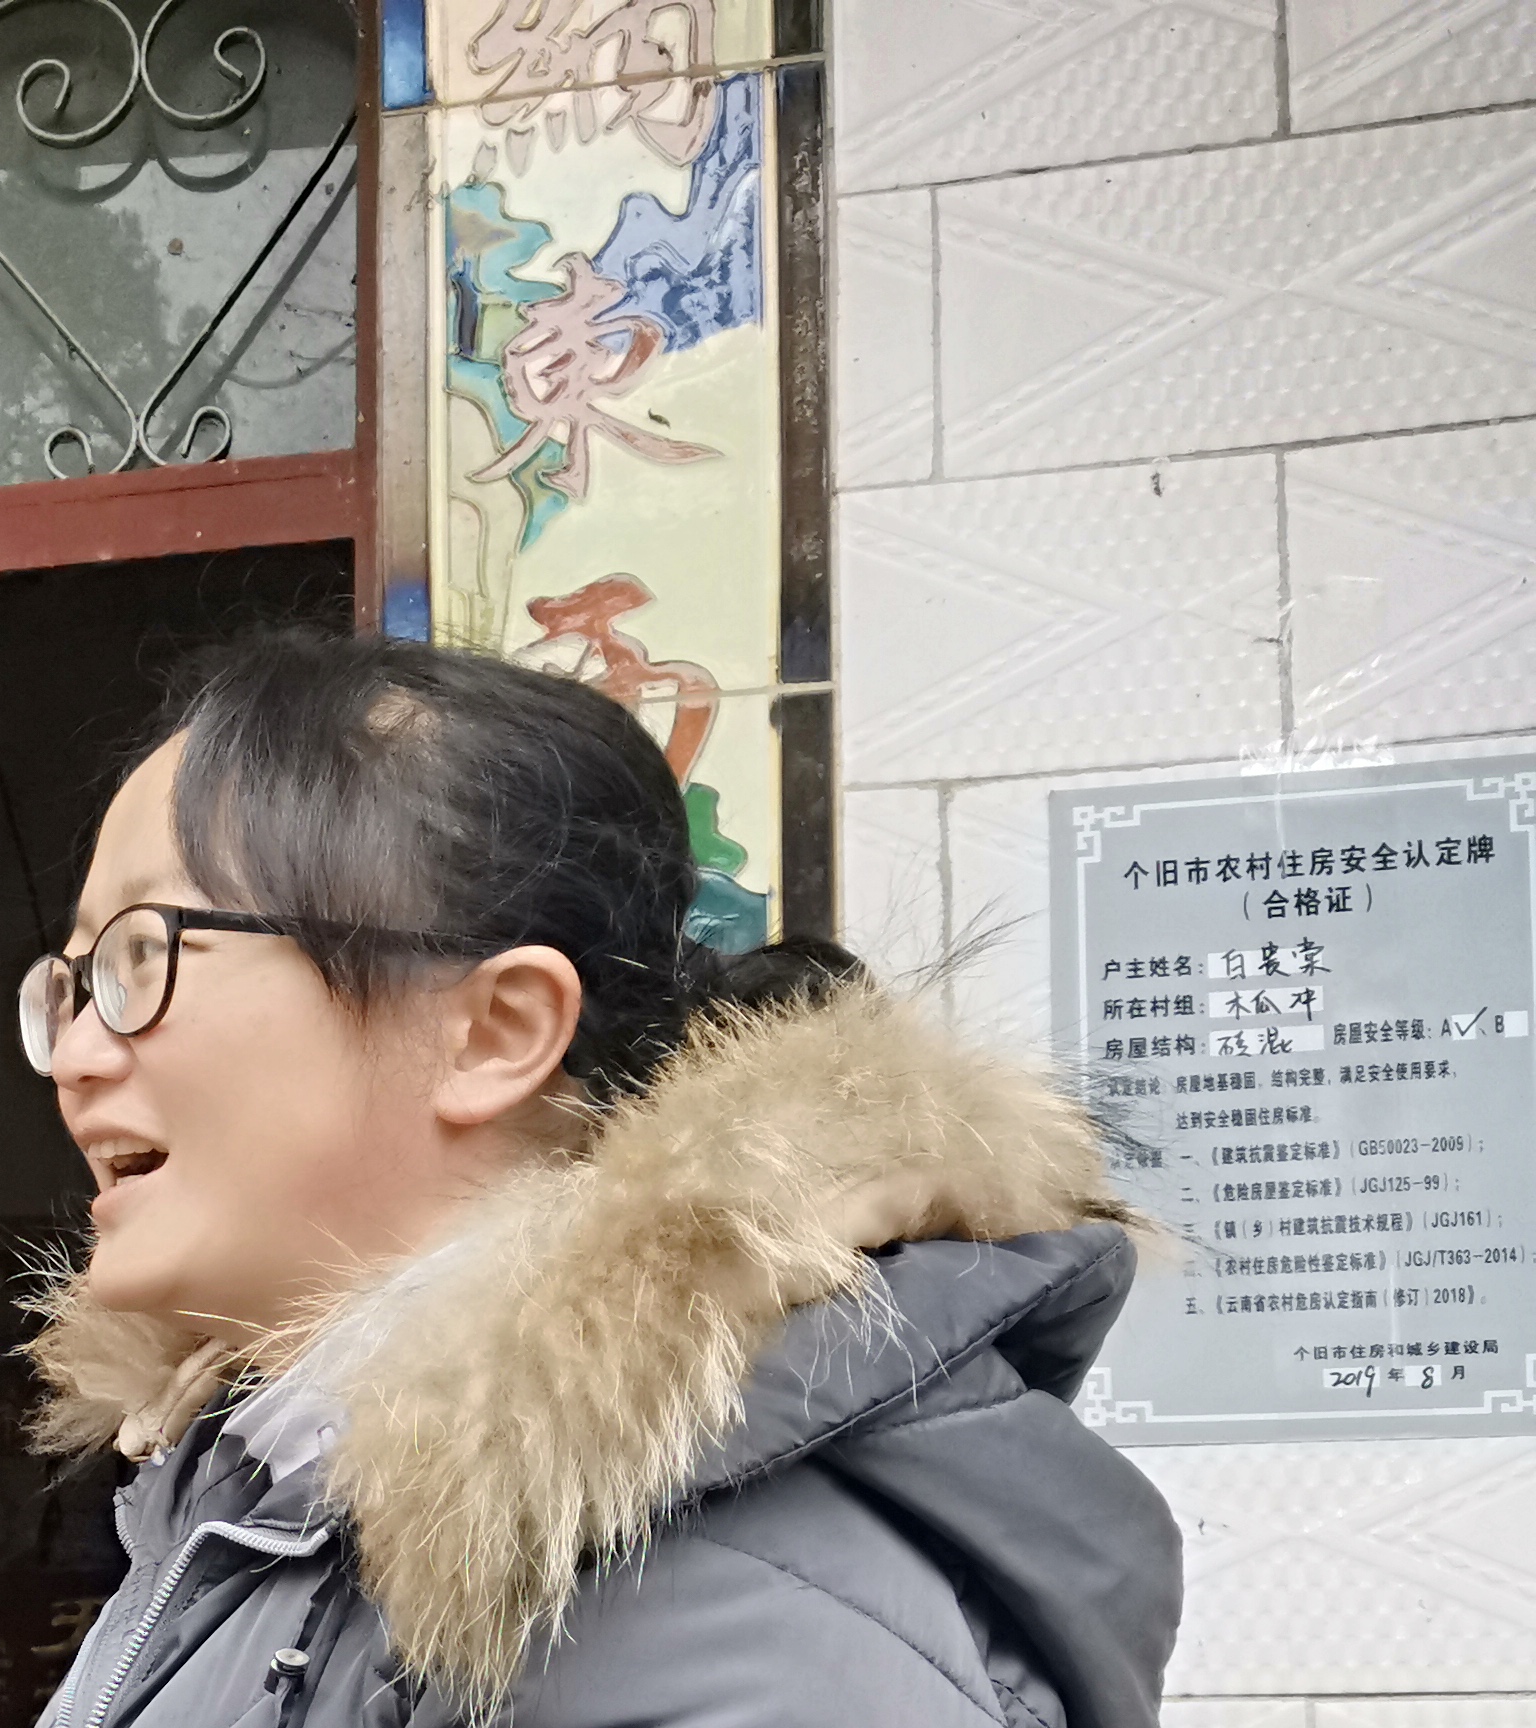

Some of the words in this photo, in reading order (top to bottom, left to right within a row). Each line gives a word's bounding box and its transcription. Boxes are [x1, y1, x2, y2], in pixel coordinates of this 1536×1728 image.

[1123, 834, 1496, 890] 个旧市农村住房安全认定牌
[1242, 883, 1373, 920] （合格证）
[1101, 955, 1204, 981] 户主姓名：
[1103, 994, 1205, 1020] 所在村组：
[1104, 1034, 1206, 1060] 房屋结构：
[1293, 1339, 1499, 1361] 个旧市住房和城乡建设局
[1329, 1364, 1377, 1398] 2019
[1387, 1368, 1405, 1382] 年
[1421, 1366, 1435, 1389] 8
[1450, 1365, 1466, 1380] 月
